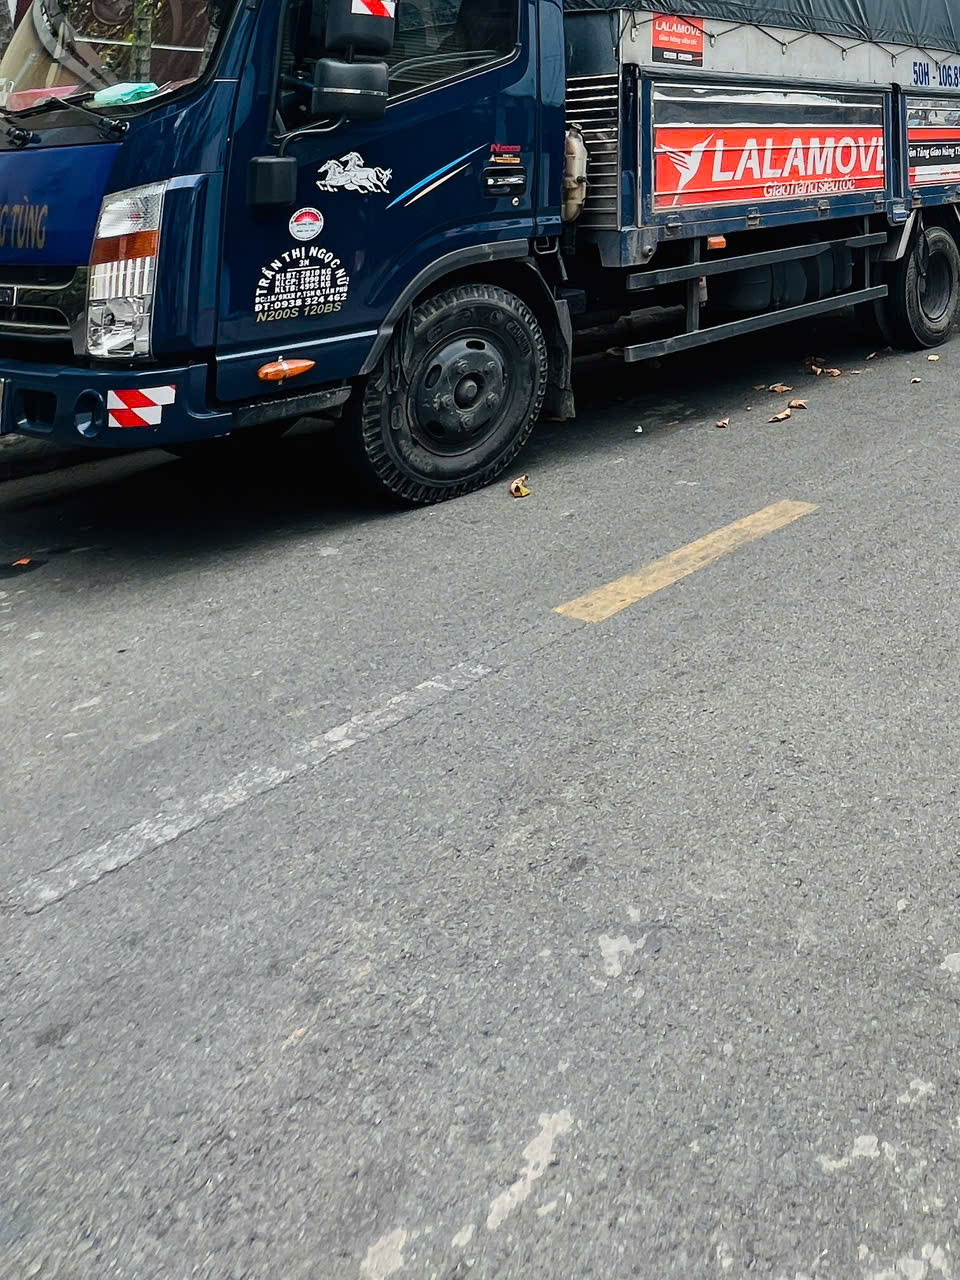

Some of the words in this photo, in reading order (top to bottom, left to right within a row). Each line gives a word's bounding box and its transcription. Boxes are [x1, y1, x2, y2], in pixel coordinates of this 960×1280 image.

[655, 21, 702, 37] LALAMOVE
[912, 61, 930, 86] 50H
[256, 260, 283, 296] TRẦN
[281, 246, 305, 262] THỊ
[309, 246, 340, 268] NGỌC
[300, 269, 320, 278] 2810
[321, 268, 332, 276] KG
[300, 276, 319, 284] 1990
[320, 274, 331, 282] KG
[305, 296, 325, 306] 324
[327, 293, 348, 302] 462
[256, 307, 299, 323] N200S
[303, 301, 342, 316] 120BS
